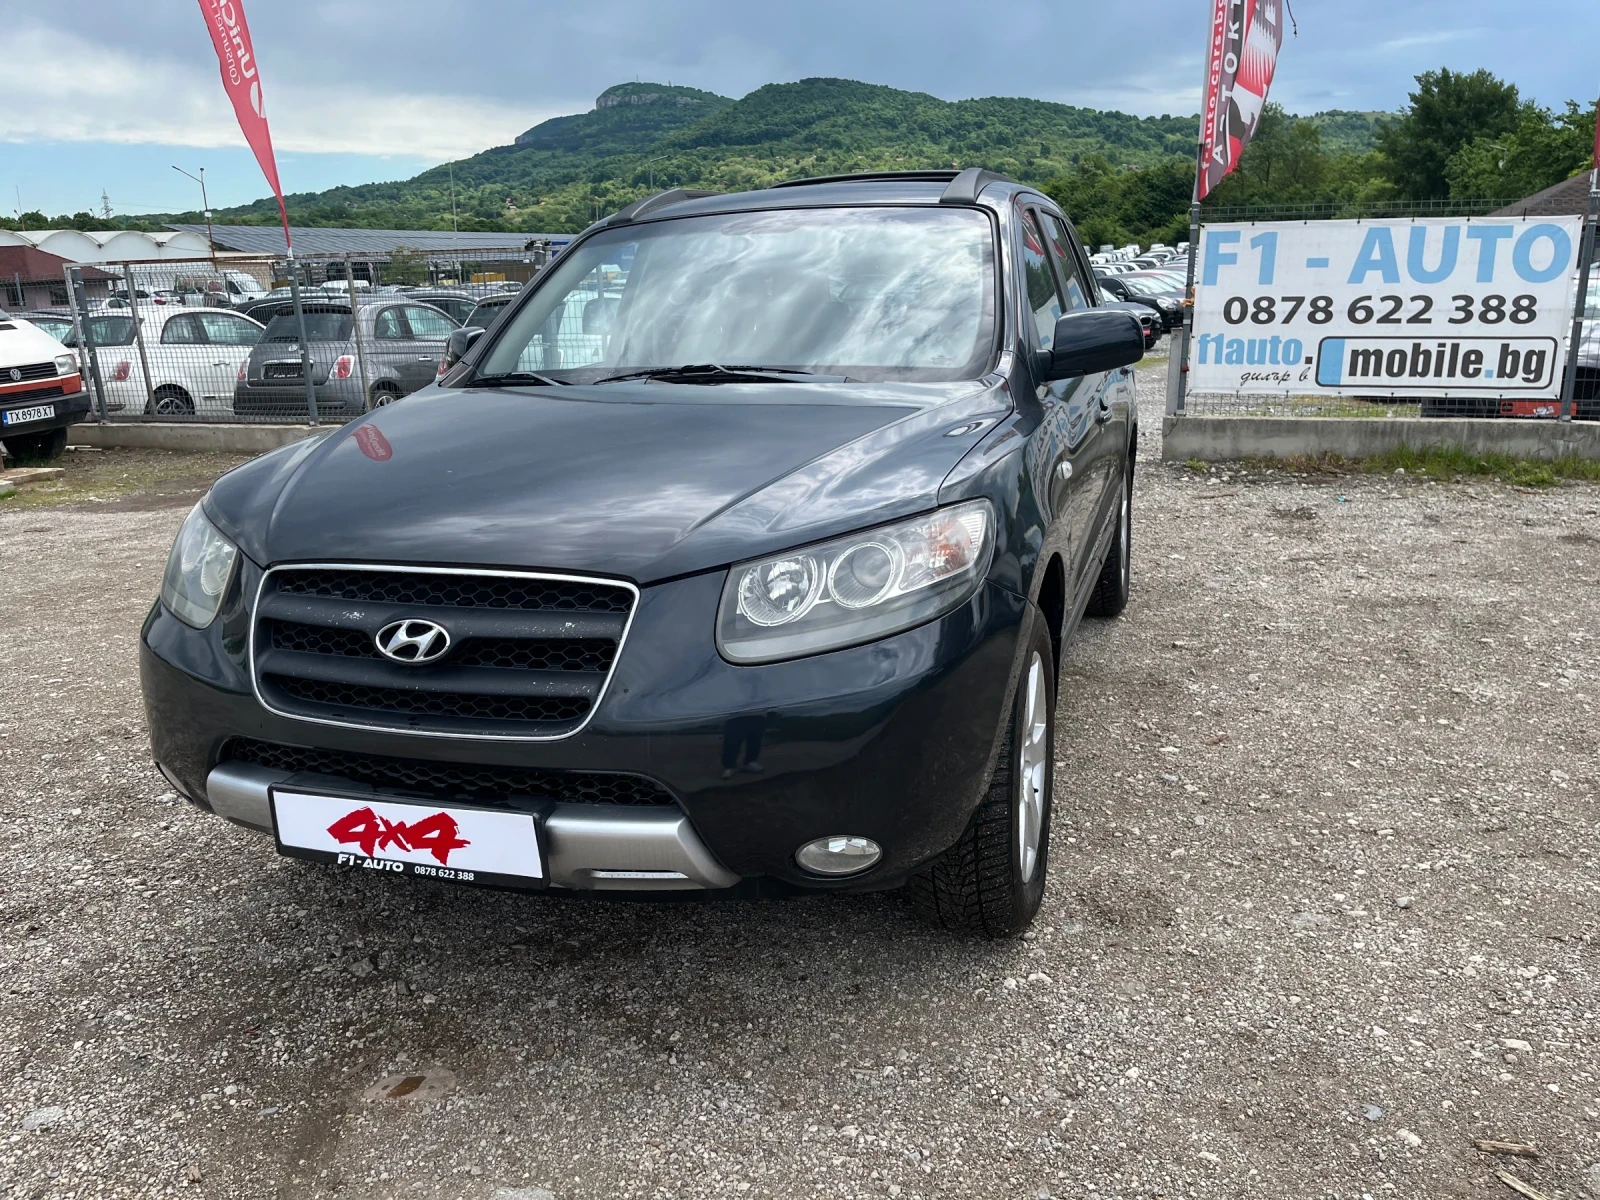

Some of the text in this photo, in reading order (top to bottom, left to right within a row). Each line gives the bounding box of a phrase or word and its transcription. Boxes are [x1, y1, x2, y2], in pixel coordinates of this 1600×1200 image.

[1202, 230, 1278, 286] F1
[1347, 223, 1572, 285] AUTO
[1223, 294, 1538, 325] 0878 622 388
[1348, 343, 1546, 383] mobile.bg
[8, 405, 53, 423] TX 8978 XT
[414, 865, 437, 876] 0878
[438, 868, 455, 879] 622
[457, 871, 474, 881] 388
